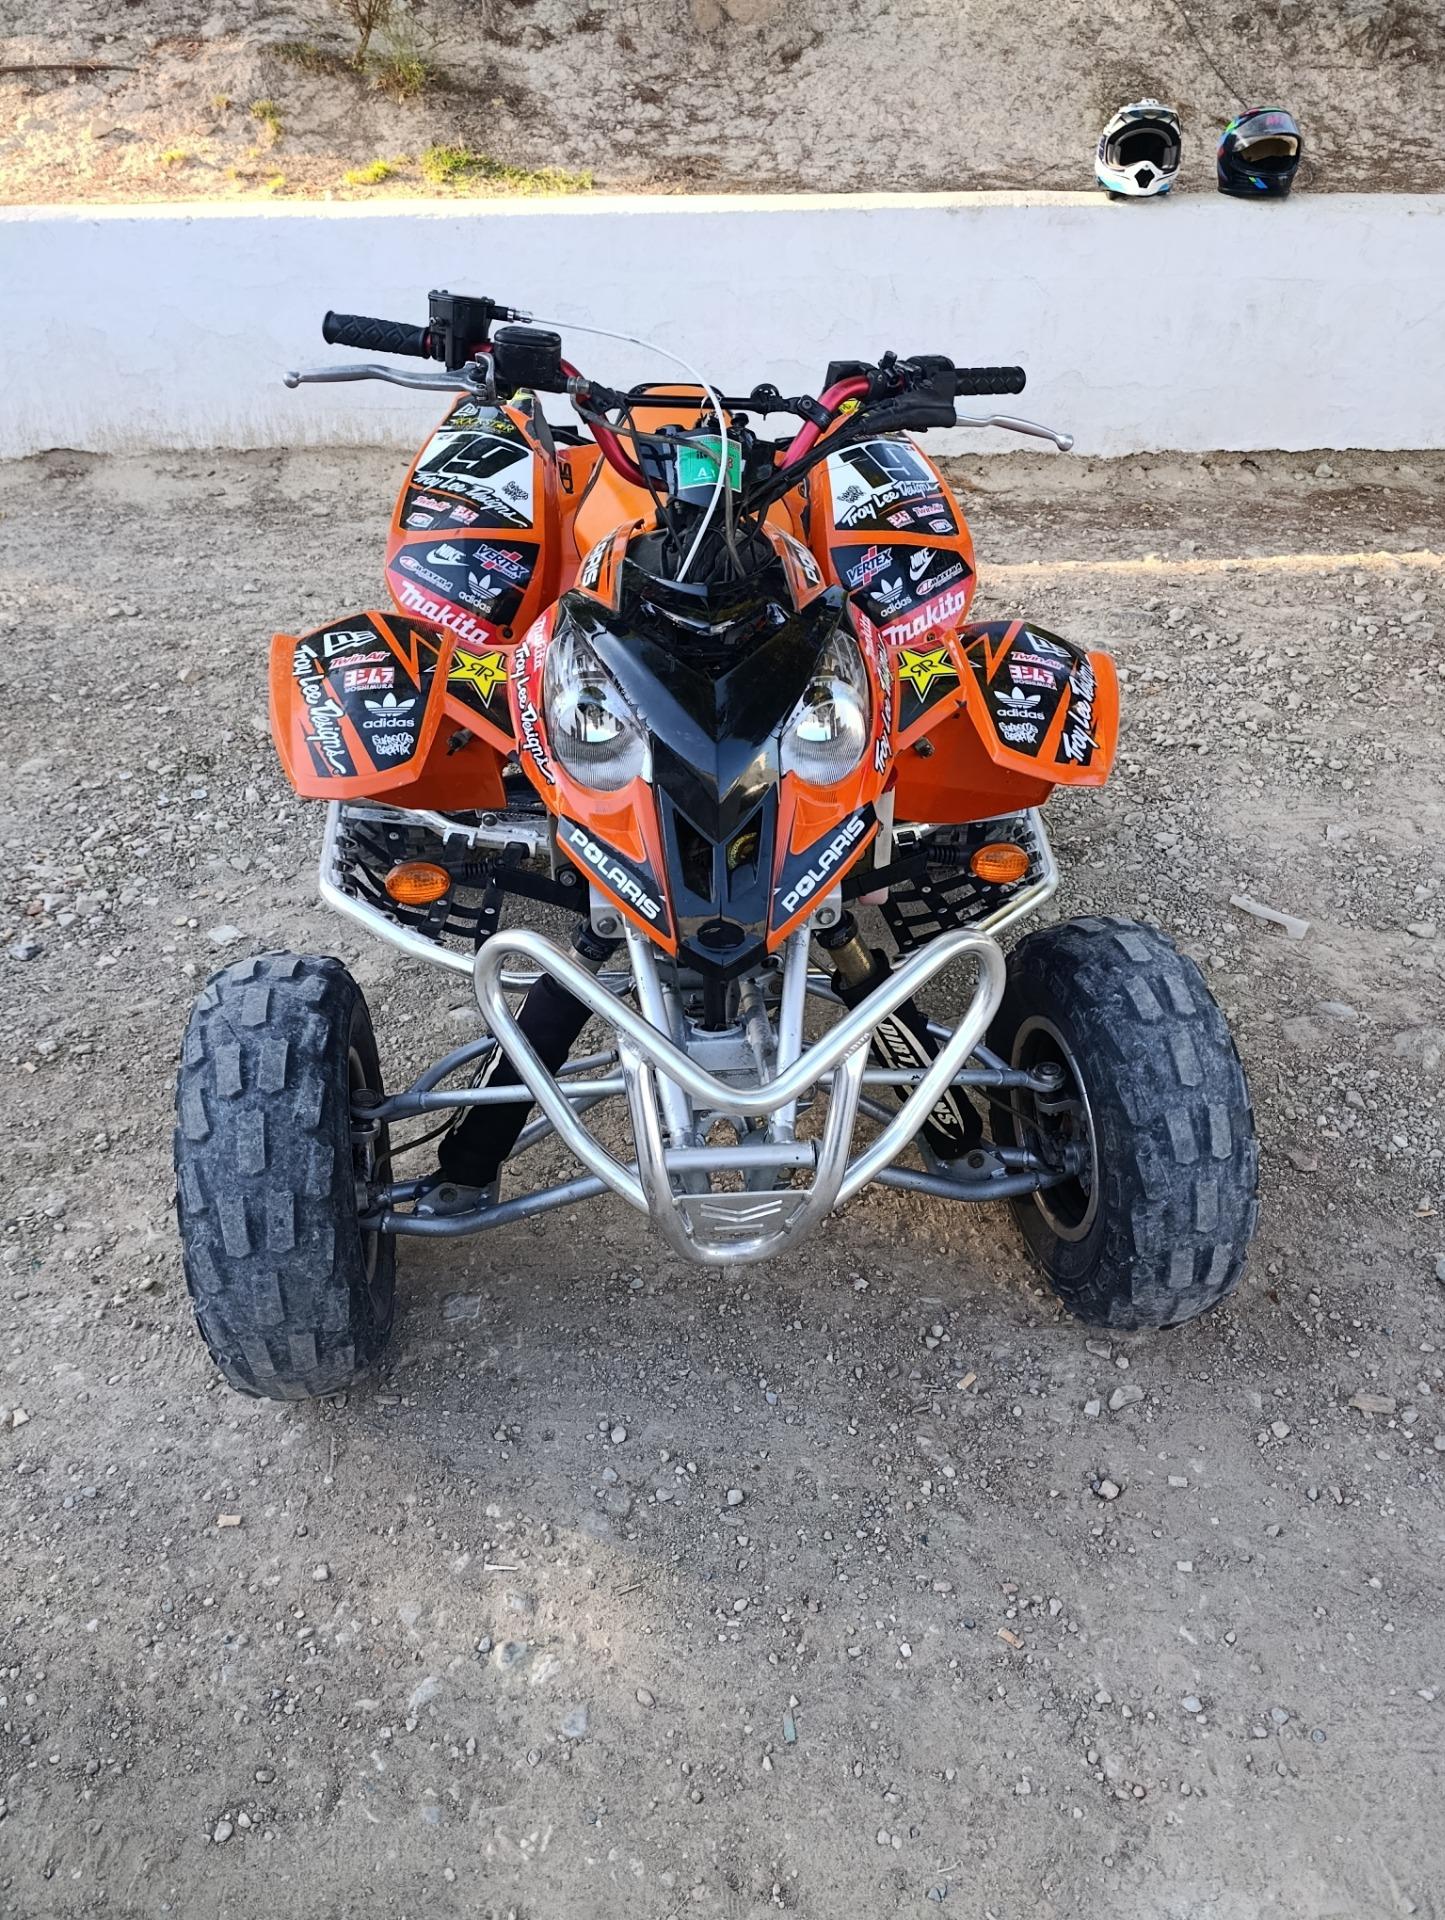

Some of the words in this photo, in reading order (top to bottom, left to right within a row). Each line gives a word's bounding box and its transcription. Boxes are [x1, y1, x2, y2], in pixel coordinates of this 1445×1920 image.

[418, 434, 528, 478] 19
[839, 443, 930, 489] 19
[439, 475, 466, 492] Lee
[466, 484, 528, 528] Designs
[841, 503, 877, 527] Troy
[872, 492, 900, 508] Lee
[434, 543, 467, 563] NIKE
[474, 544, 529, 577] VERTEX
[847, 549, 893, 585] VERTEX
[909, 547, 931, 568] NIKE
[400, 580, 490, 645] makita
[459, 591, 492, 614] adidas
[880, 596, 912, 617] adidas
[881, 591, 965, 645] makita
[292, 644, 318, 677] Troy
[329, 655, 364, 669] Twin
[364, 651, 391, 662] Air
[511, 640, 530, 679] Troy
[299, 674, 324, 705] Lee
[344, 683, 394, 693] YOSHIMURA
[515, 676, 530, 710] Lee
[362, 717, 415, 728] adidas
[996, 709, 1045, 720] adidas
[1068, 700, 1091, 730] Lee
[306, 698, 347, 774] Designs
[521, 703, 555, 784] Designs
[1062, 724, 1100, 762] Troy
[569, 828, 661, 920] POLARIS
[781, 816, 866, 913] POLARIS
